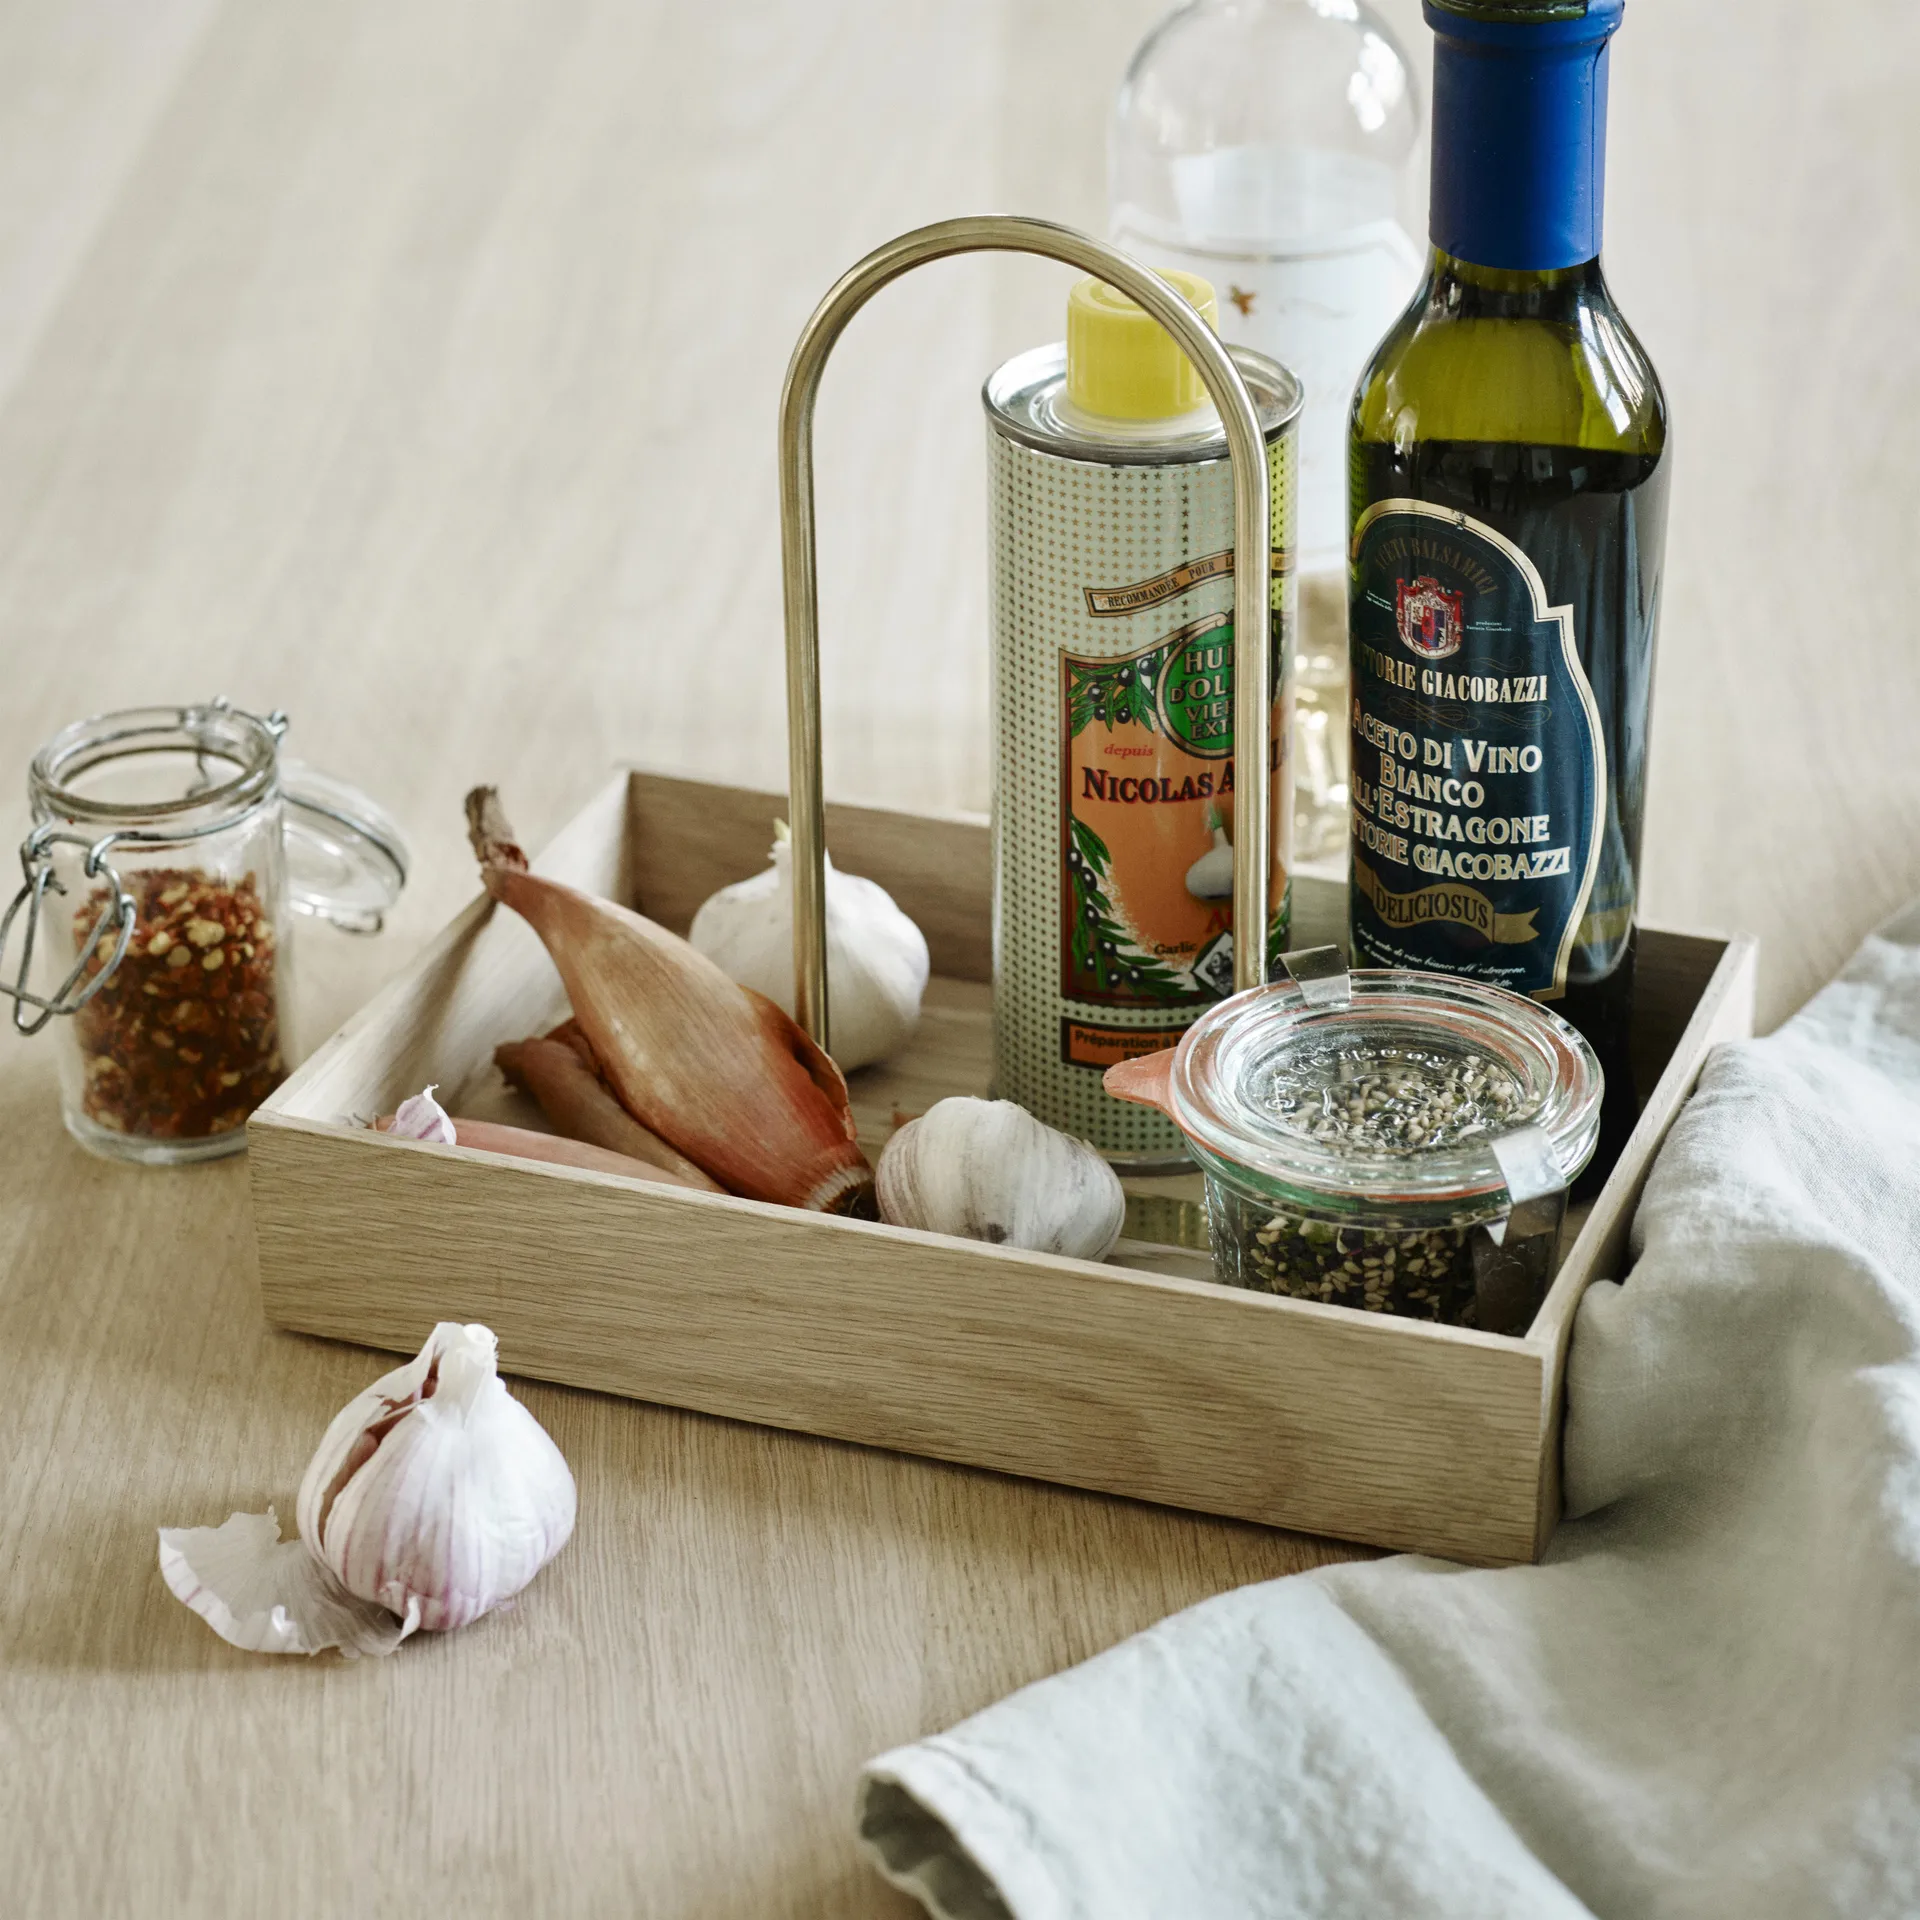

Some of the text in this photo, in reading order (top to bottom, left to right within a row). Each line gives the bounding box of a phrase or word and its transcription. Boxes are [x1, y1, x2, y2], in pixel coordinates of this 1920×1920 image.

[1107, 575, 1180, 608] RECOMMANDÉE
[1188, 561, 1215, 580] POUR
[1182, 644, 1235, 675] HUI
[1421, 669, 1548, 703] GIACOBAZZI
[1189, 719, 1235, 742] EXT
[1351, 698, 1543, 774] ACETO DI VINO
[1103, 743, 1154, 758] depuis
[1081, 765, 1215, 805] NICOLAS
[1379, 751, 1485, 809] BIANCO
[1412, 842, 1571, 881] GIACOBAZZI
[1374, 886, 1489, 929] DELICIOSUS
[1153, 941, 1199, 956] Garlic
[1424, 955, 1456, 971] bianco
[1074, 1029, 1159, 1050] Préparation
